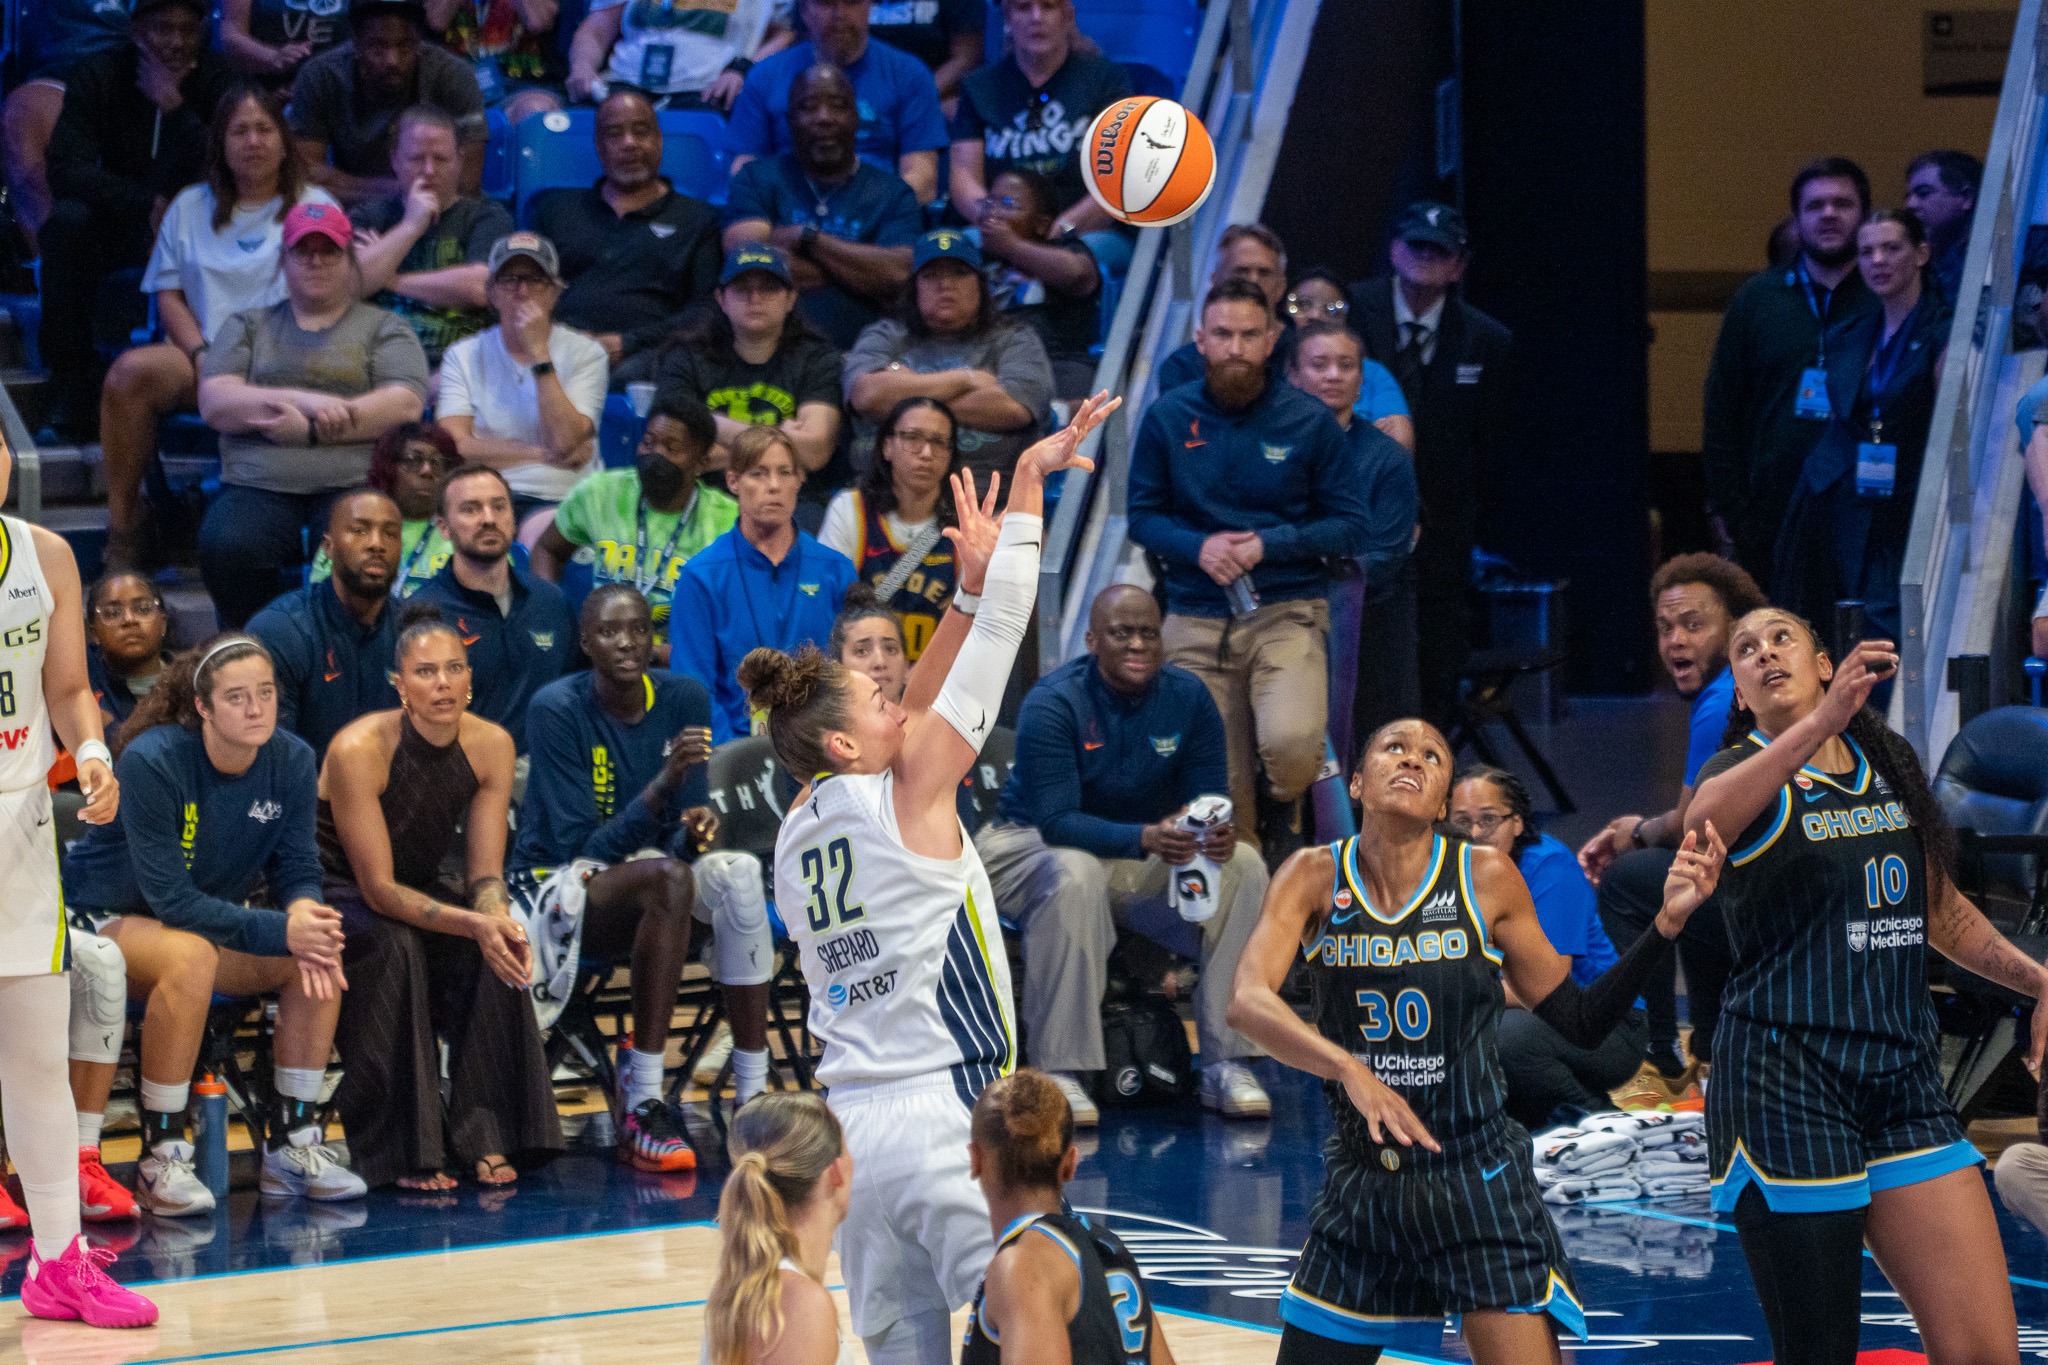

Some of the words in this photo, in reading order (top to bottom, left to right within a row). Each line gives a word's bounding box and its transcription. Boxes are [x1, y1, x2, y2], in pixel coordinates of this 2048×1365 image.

[1097, 102, 1140, 176] Wilson
[8, 586, 37, 600] Albert
[0, 726, 29, 751] VS
[1802, 801, 1916, 841] CHICAG
[800, 833, 868, 937] 32
[1864, 854, 1909, 909] 10
[1870, 916, 1923, 934] UChicago
[1870, 931, 1924, 951] Medicine
[817, 929, 880, 974] SHEPARD
[1322, 929, 1469, 967] CHICAGO
[849, 969, 898, 1006] AT&T
[1356, 987, 1432, 1042] 30
[1374, 1054, 1445, 1072] UChicago
[1374, 1070, 1446, 1087] Medicine
